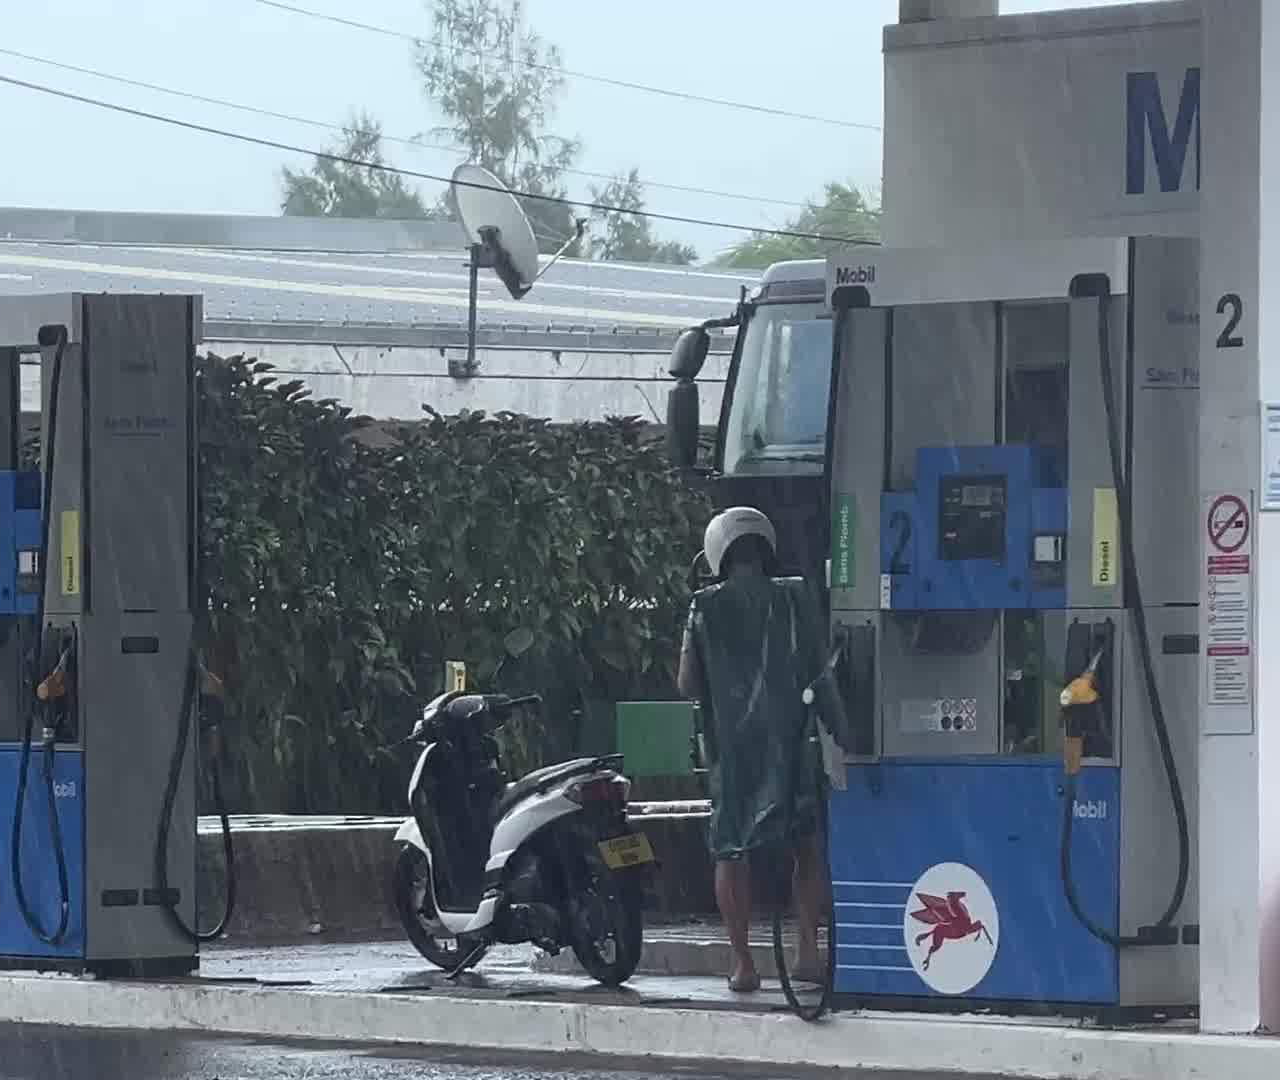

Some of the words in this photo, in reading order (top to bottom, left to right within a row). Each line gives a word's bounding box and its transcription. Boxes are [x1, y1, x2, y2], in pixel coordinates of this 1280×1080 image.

[836, 265, 876, 285] Mobil
[1216, 293, 1244, 348] 2
[887, 510, 912, 575] 2
[54, 780, 76, 798] obil
